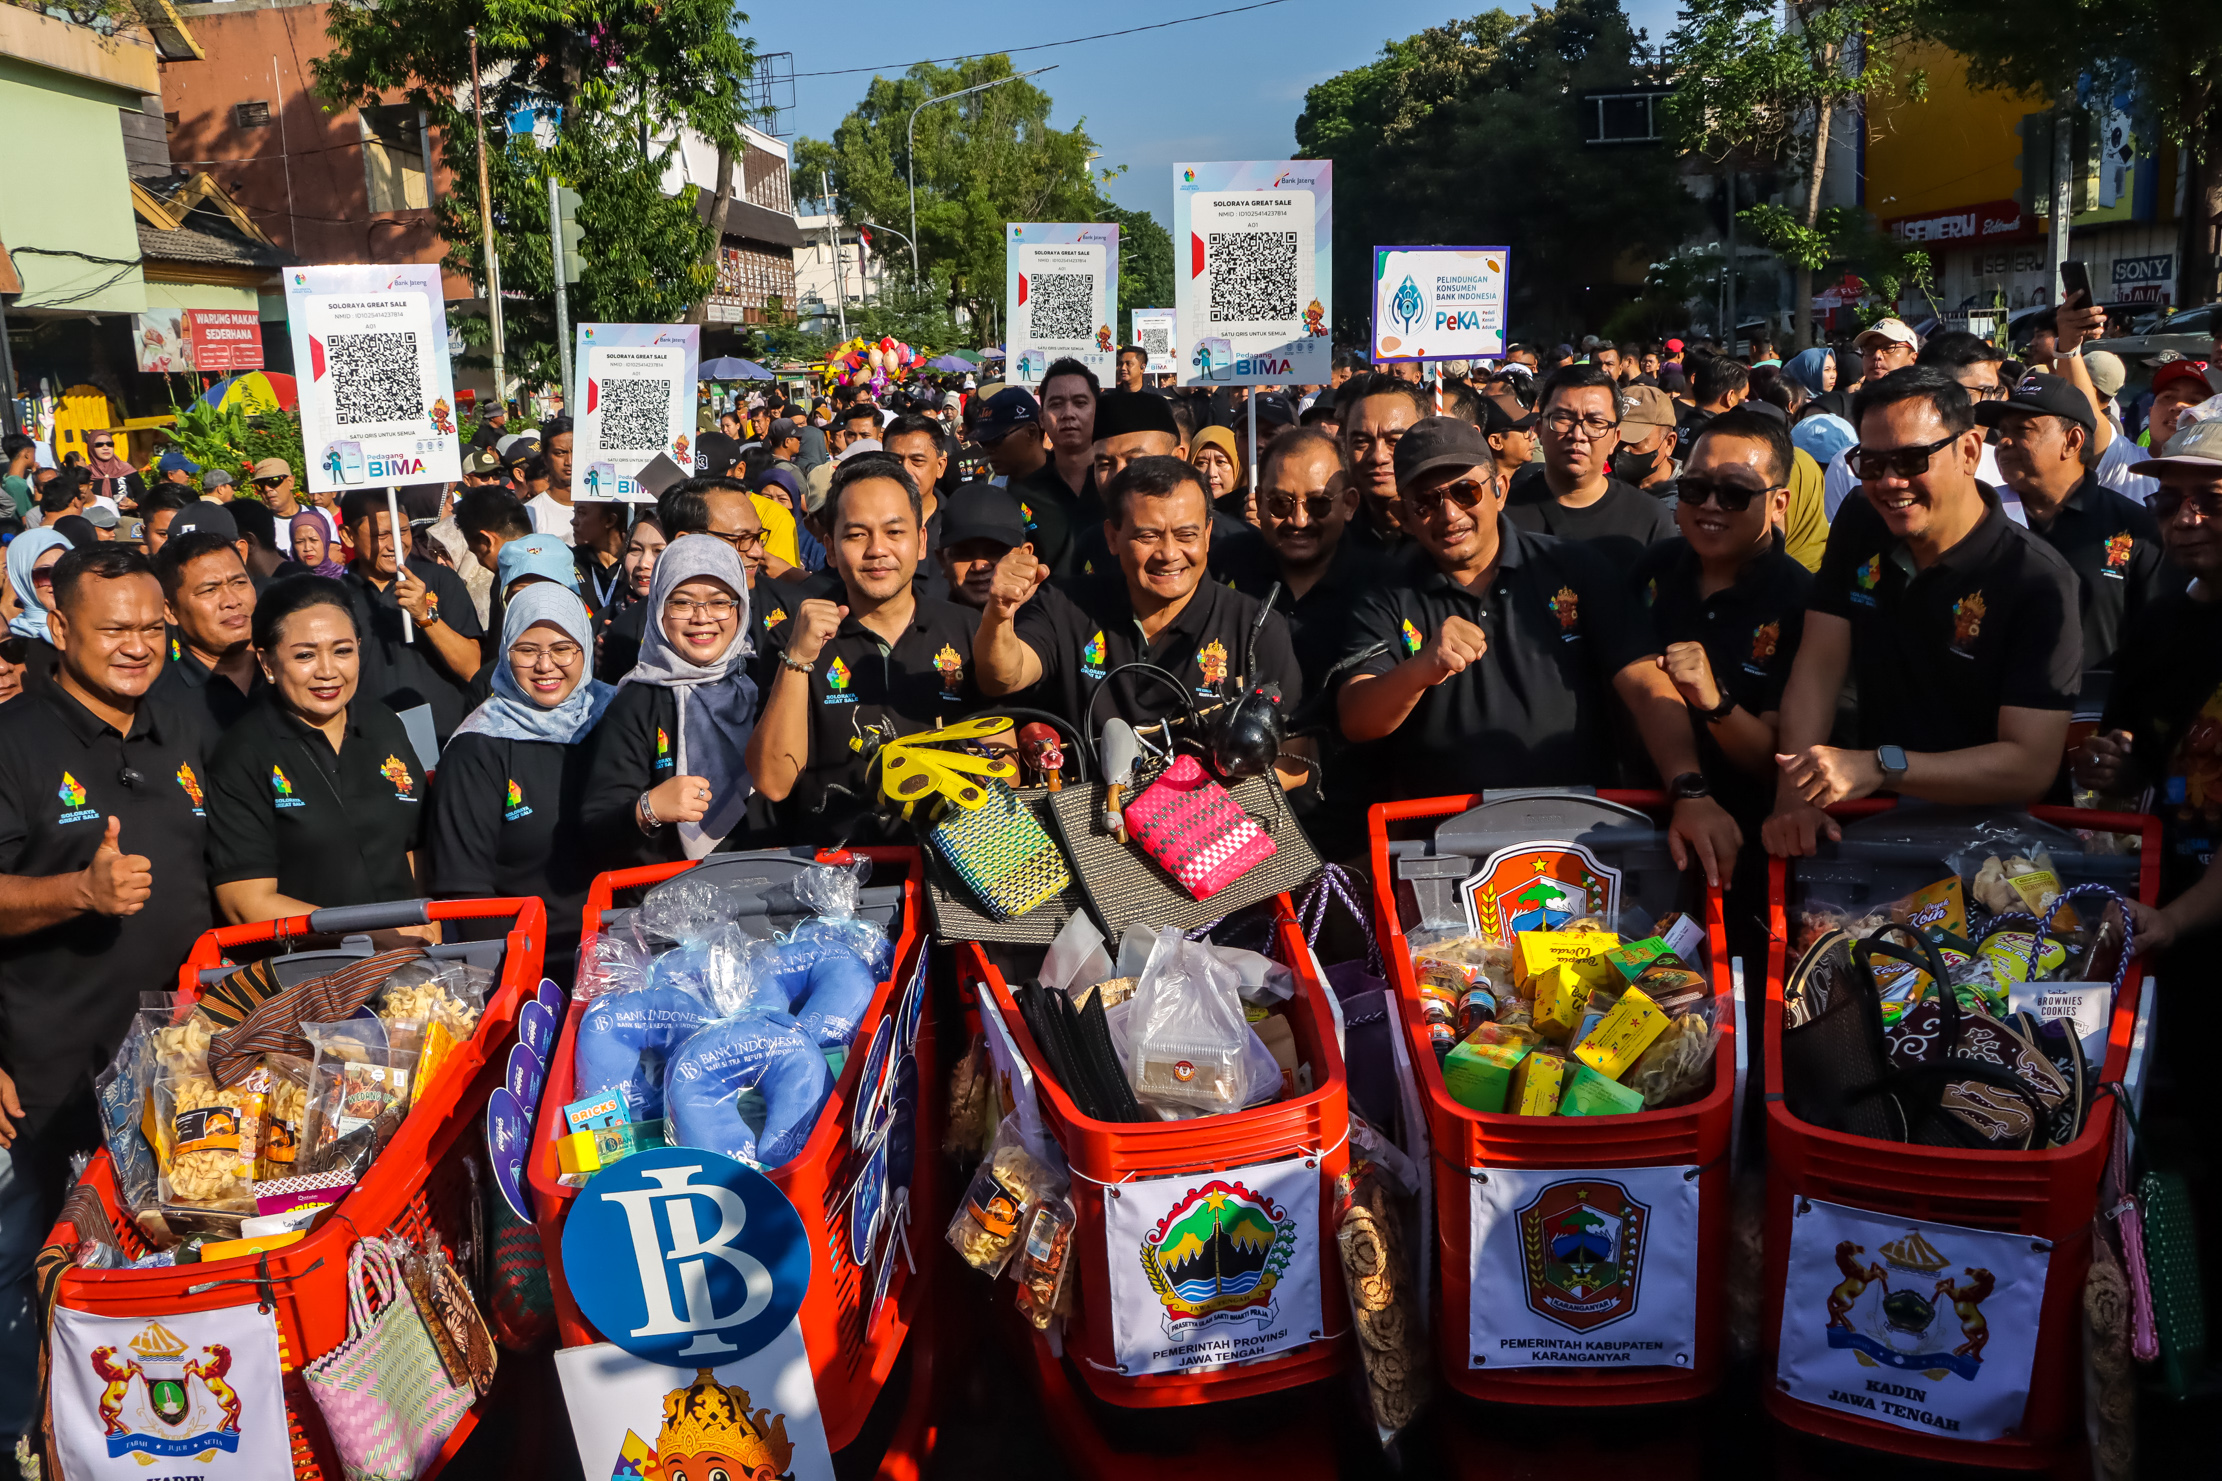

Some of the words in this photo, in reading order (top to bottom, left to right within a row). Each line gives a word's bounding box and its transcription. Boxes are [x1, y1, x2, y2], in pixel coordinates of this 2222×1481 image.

[1905, 213, 1976, 241] SEMERU
[1985, 251, 2045, 273] SEMERU
[2115, 259, 2168, 280] SONY
[1436, 276, 1488, 284] PELINDUNGAN
[1436, 293, 1456, 301] BANK
[366, 301, 389, 309] GREAT
[195, 313, 231, 325] WARUNG
[231, 314, 259, 325] MAKAN
[1435, 310, 1480, 331] PeKA
[205, 329, 253, 340] SEDERHANA
[1236, 359, 1295, 375] BIMA
[366, 453, 404, 461] Pedagang
[368, 458, 427, 477] BIMA
[618, 480, 652, 494] BIM
[1907, 908, 1948, 928] Koin
[1549, 947, 1591, 958] Wirda
[1556, 956, 1598, 967] Bakpia
[2037, 996, 2083, 1007] BROWNIES
[615, 1011, 646, 1021] BANK
[647, 1009, 707, 1023] INDONES
[2041, 1006, 2077, 1017] COOKIES
[699, 1046, 732, 1065] BANK
[733, 1036, 806, 1056] INDONESIA
[348, 1091, 382, 1105] WEDANG
[570, 1099, 617, 1124] BRICKS
[1217, 1295, 1251, 1307] TENGAH
[1553, 1299, 1610, 1312] KARANGANYAR
[1171, 1319, 1198, 1333] PRASETYA
[1213, 1312, 1229, 1322] SAKTI
[1229, 1310, 1249, 1321] BHAKTI
[1250, 1308, 1269, 1319] PRAJA
[1153, 1338, 1230, 1360] PEMERINTAH
[1233, 1328, 1288, 1348] PROVINSI
[1500, 1339, 1582, 1350] PEMERINTAH
[1585, 1340, 1663, 1351] KABUPATEN
[1178, 1353, 1213, 1367] JAWA
[1214, 1347, 1265, 1362] TENGAH
[1532, 1351, 1631, 1362] KARANGANYAR
[1865, 1379, 1927, 1403] KADIN
[1828, 1390, 1878, 1412] JAWA
[1880, 1401, 1961, 1432] TENGAH
[203, 1438, 223, 1447] SETIA
